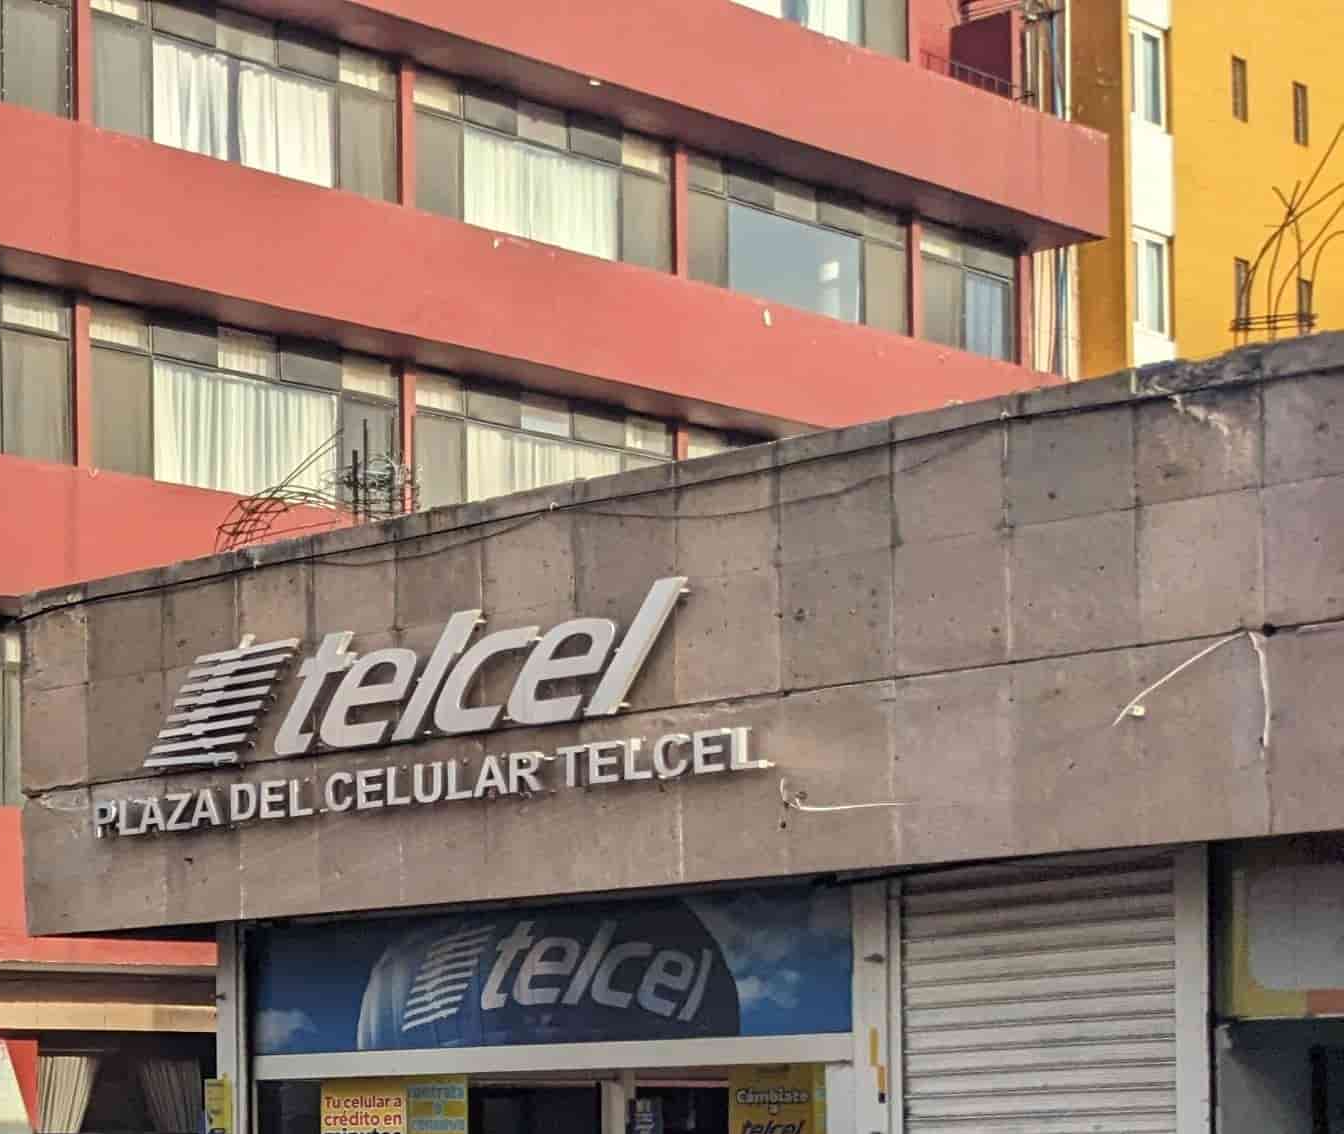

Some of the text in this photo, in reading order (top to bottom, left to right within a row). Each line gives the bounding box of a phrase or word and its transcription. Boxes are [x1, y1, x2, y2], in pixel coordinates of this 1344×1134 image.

[274, 575, 689, 756] telcel
[93, 726, 775, 838] PLAZA DEL CELULAR TELCEL
[480, 920, 713, 1022] telcel
[324, 1111, 380, 1126] crédito
[384, 1114, 402, 1126] en
[325, 1096, 402, 1109] Tu celular a
